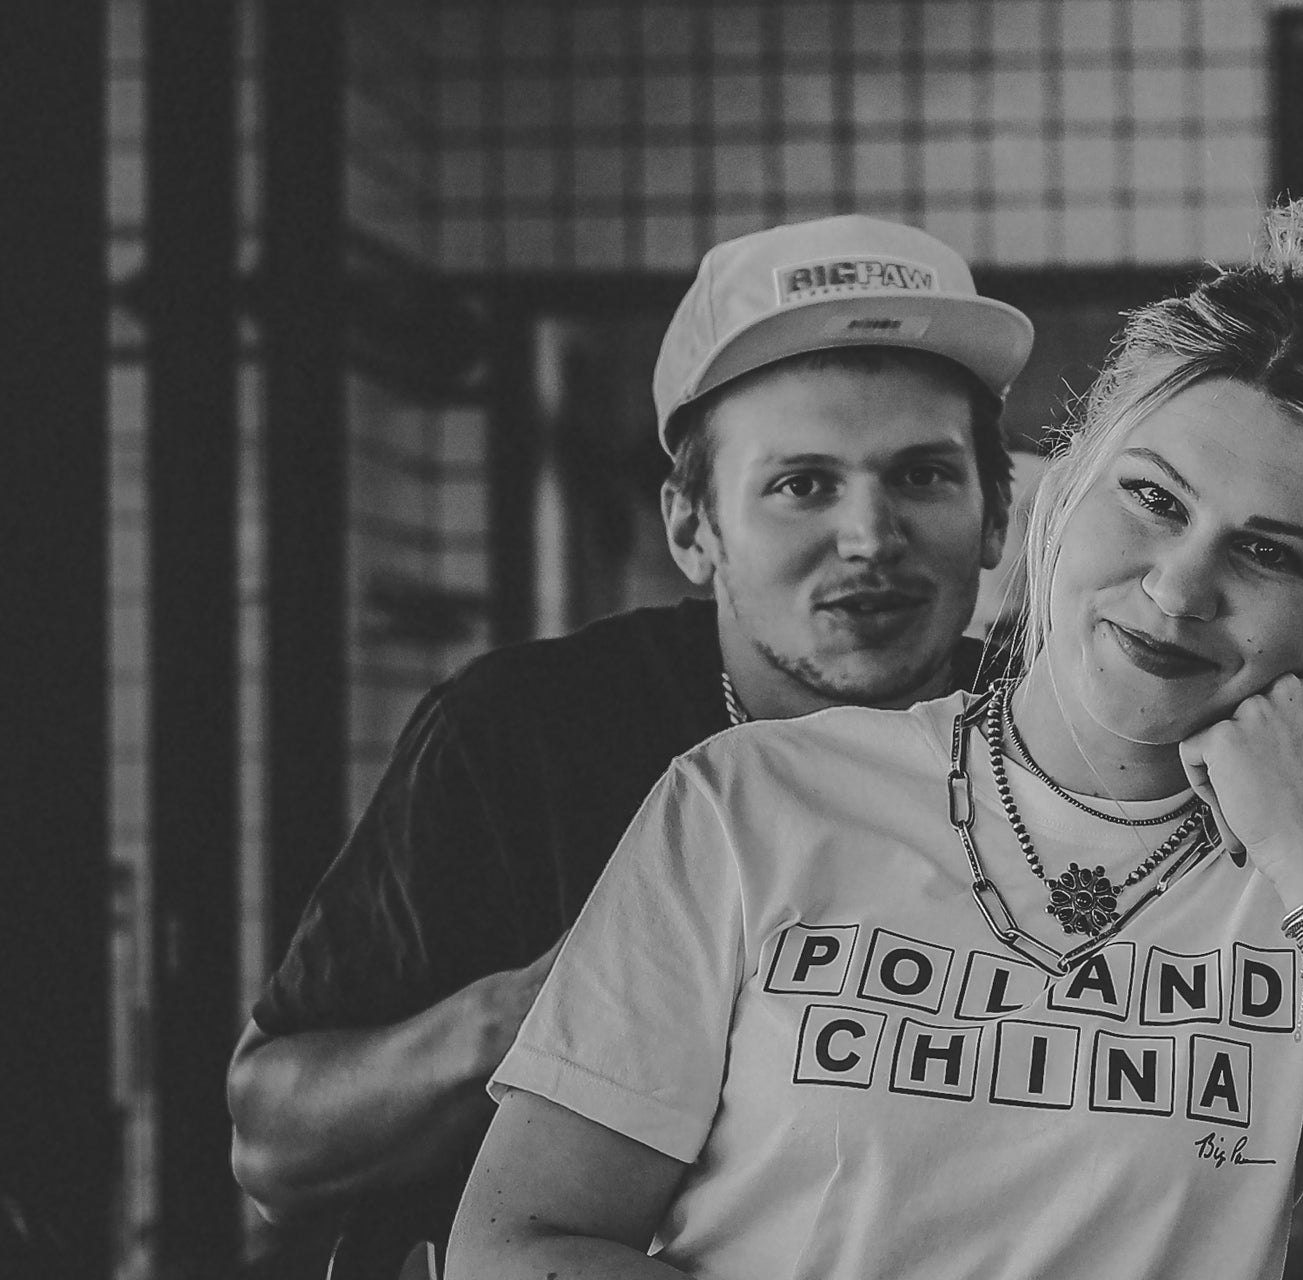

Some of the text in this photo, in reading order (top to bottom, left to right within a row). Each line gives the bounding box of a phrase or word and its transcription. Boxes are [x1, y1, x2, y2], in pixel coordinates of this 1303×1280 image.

[792, 935, 1283, 1018] POLAND
[815, 1018, 1240, 1113] CHINA
[1195, 1132, 1226, 1168] Big
